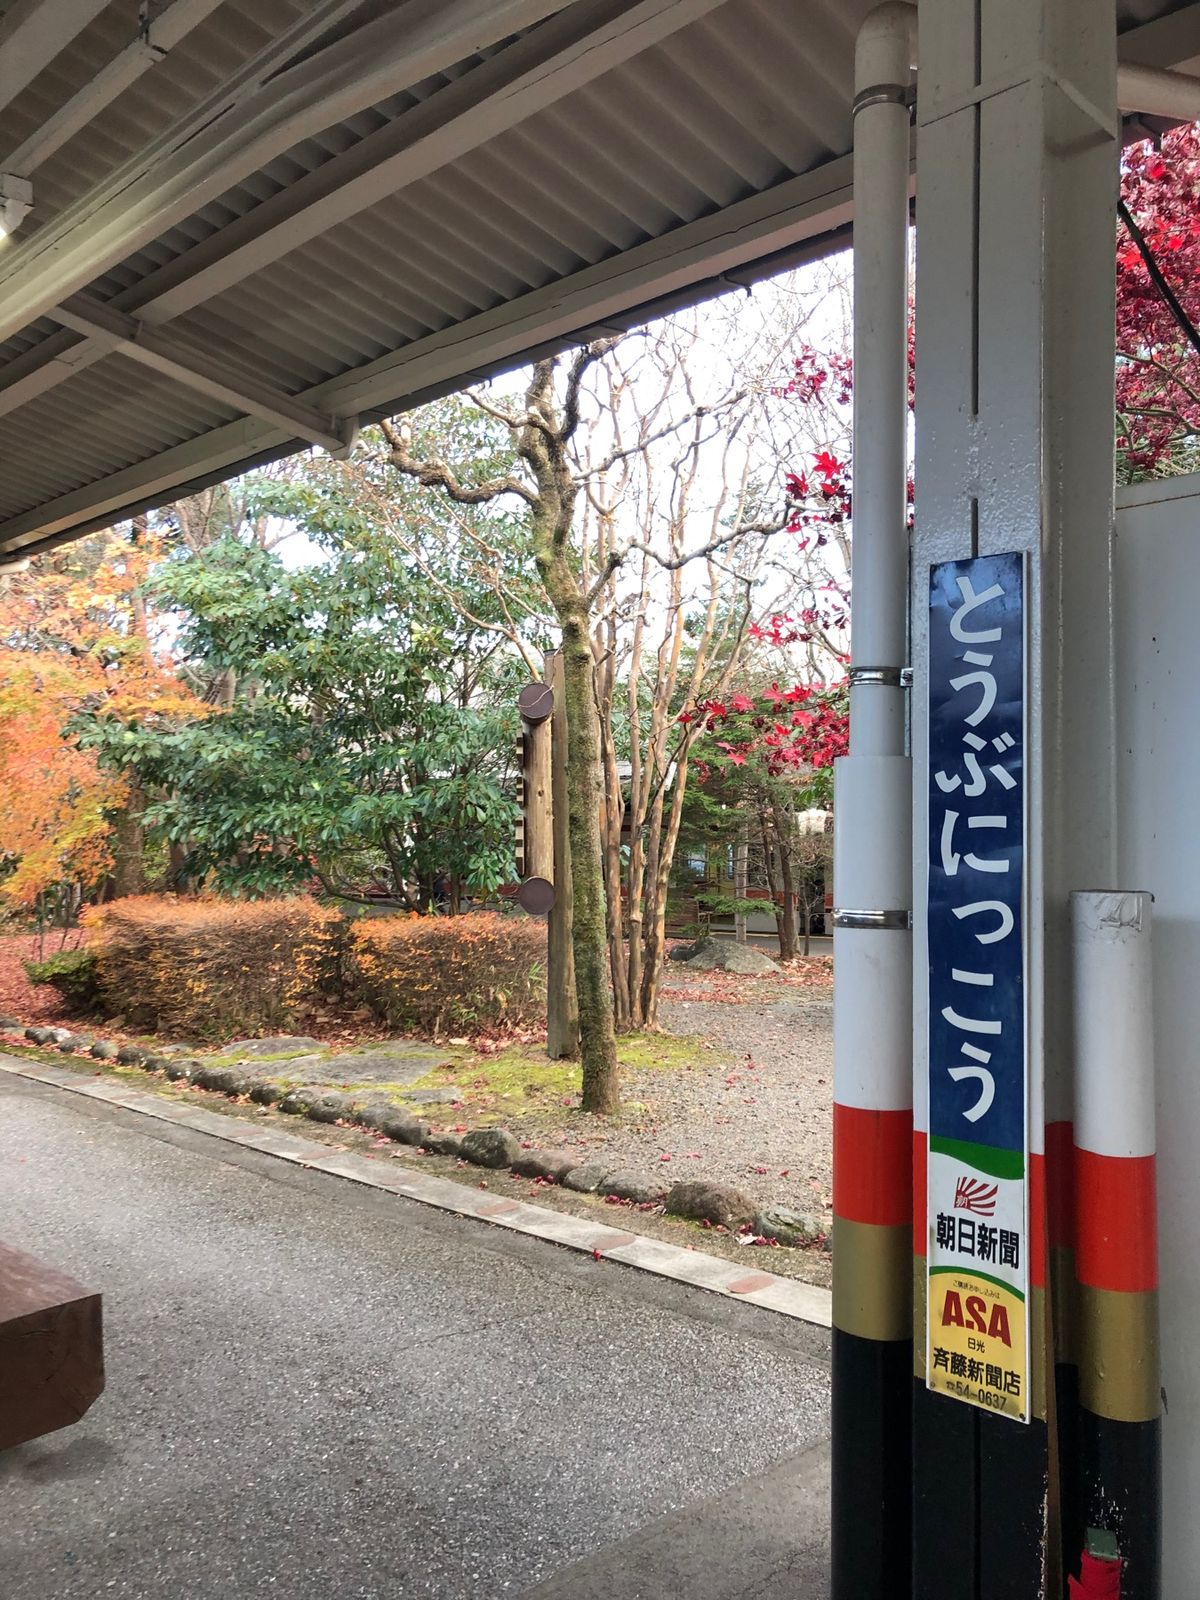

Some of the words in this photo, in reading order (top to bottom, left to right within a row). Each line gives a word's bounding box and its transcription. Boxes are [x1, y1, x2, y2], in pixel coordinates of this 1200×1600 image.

[934, 576, 1018, 1122] とうぶにっこう
[936, 1212, 1020, 1269] 朝日新聞
[941, 1290, 1012, 1348] ASA
[967, 1337, 986, 1354] 日光
[933, 1346, 1021, 1397] 斉藤新聞店
